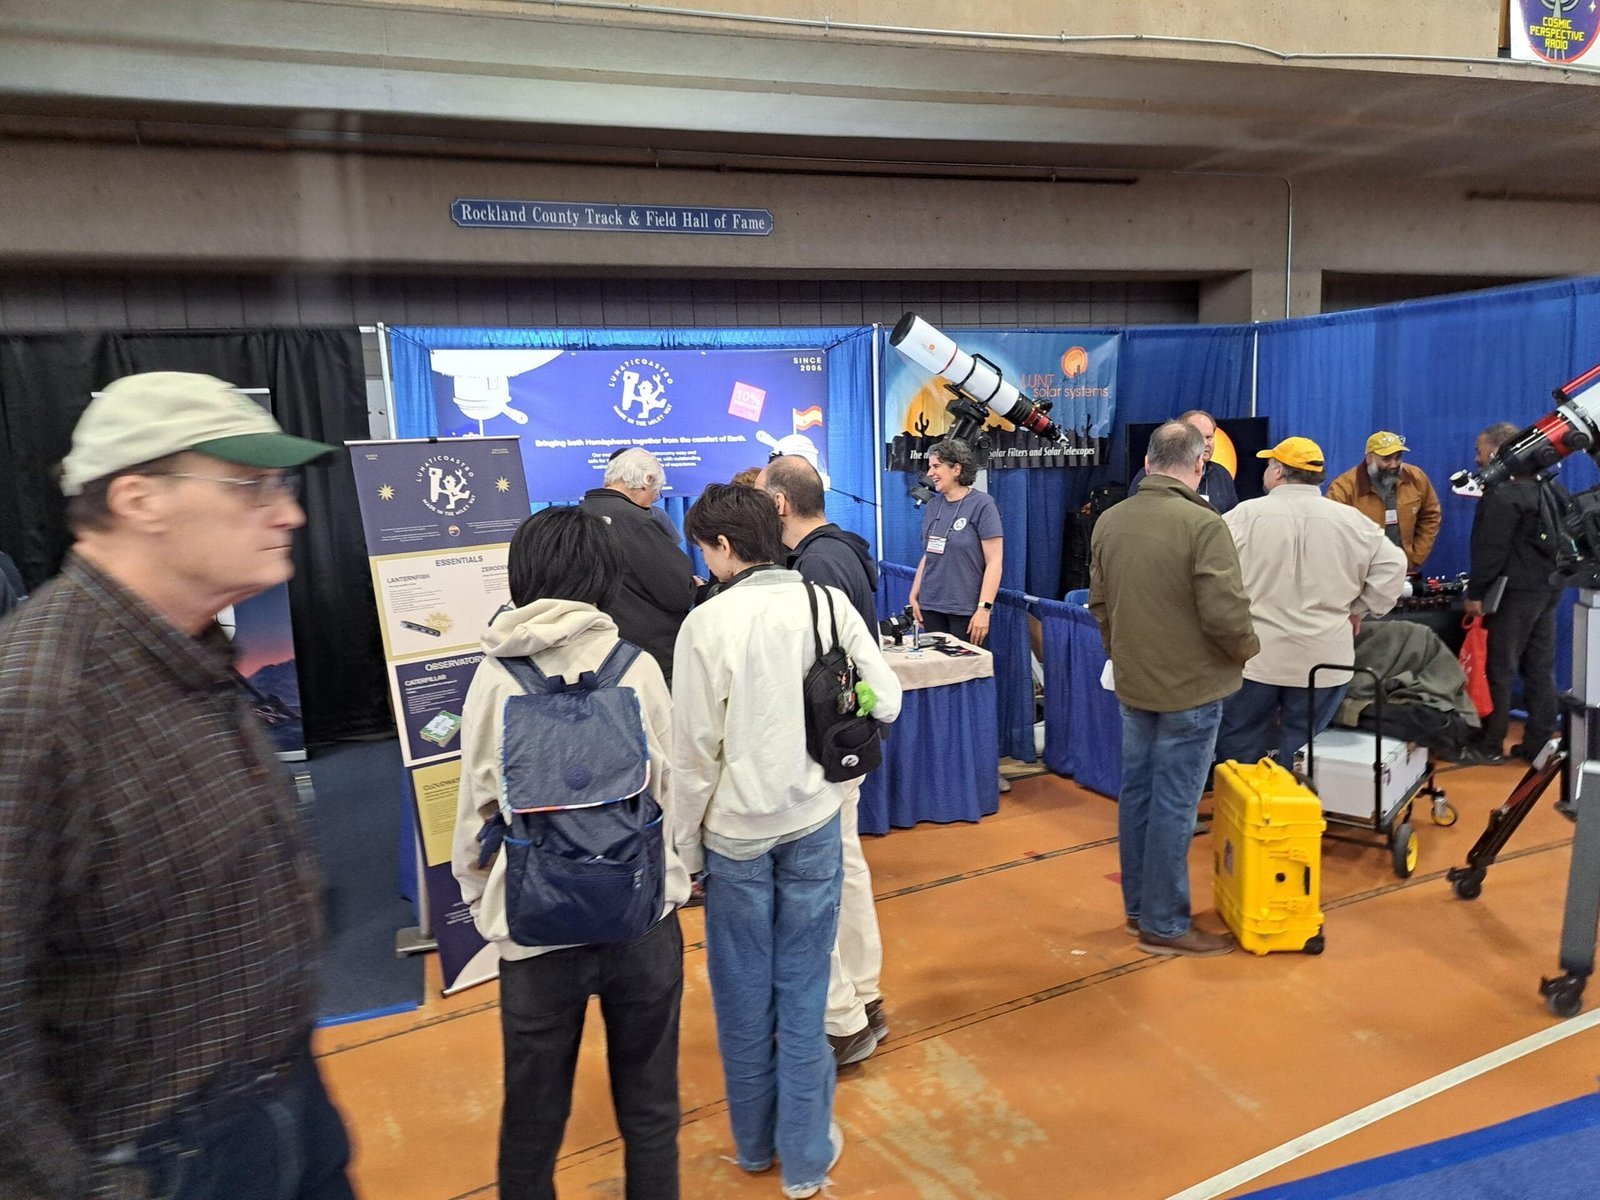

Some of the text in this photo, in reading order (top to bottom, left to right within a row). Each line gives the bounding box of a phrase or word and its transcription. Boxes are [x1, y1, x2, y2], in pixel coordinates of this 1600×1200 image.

[1542, 16, 1572, 29] COSMIC
[1529, 25, 1585, 41] PERSPECTIVE
[1545, 38, 1569, 50] RADIO
[460, 203, 765, 230] Rockland County Track & Field Hall of Fame
[608, 358, 674, 388] LUNATICOASTRO
[800, 364, 822, 372] 2006
[1020, 373, 1055, 388] LUNT
[1033, 385, 1109, 399] solar systems
[534, 439, 566, 448] Bringing
[632, 437, 661, 446] together
[662, 436, 679, 444] from
[692, 435, 718, 443] comfort
[910, 449, 922, 460] The
[1007, 447, 1028, 457] Filters
[1029, 447, 1042, 456] and
[1043, 446, 1061, 456] Solar
[1063, 446, 1095, 457] Telescopes
[416, 455, 474, 482] LUNATICOASTRO
[435, 555, 484, 567] ESSENTIALS
[386, 573, 431, 584] LANTERNFISH
[404, 674, 447, 686] CATERPILLAR
